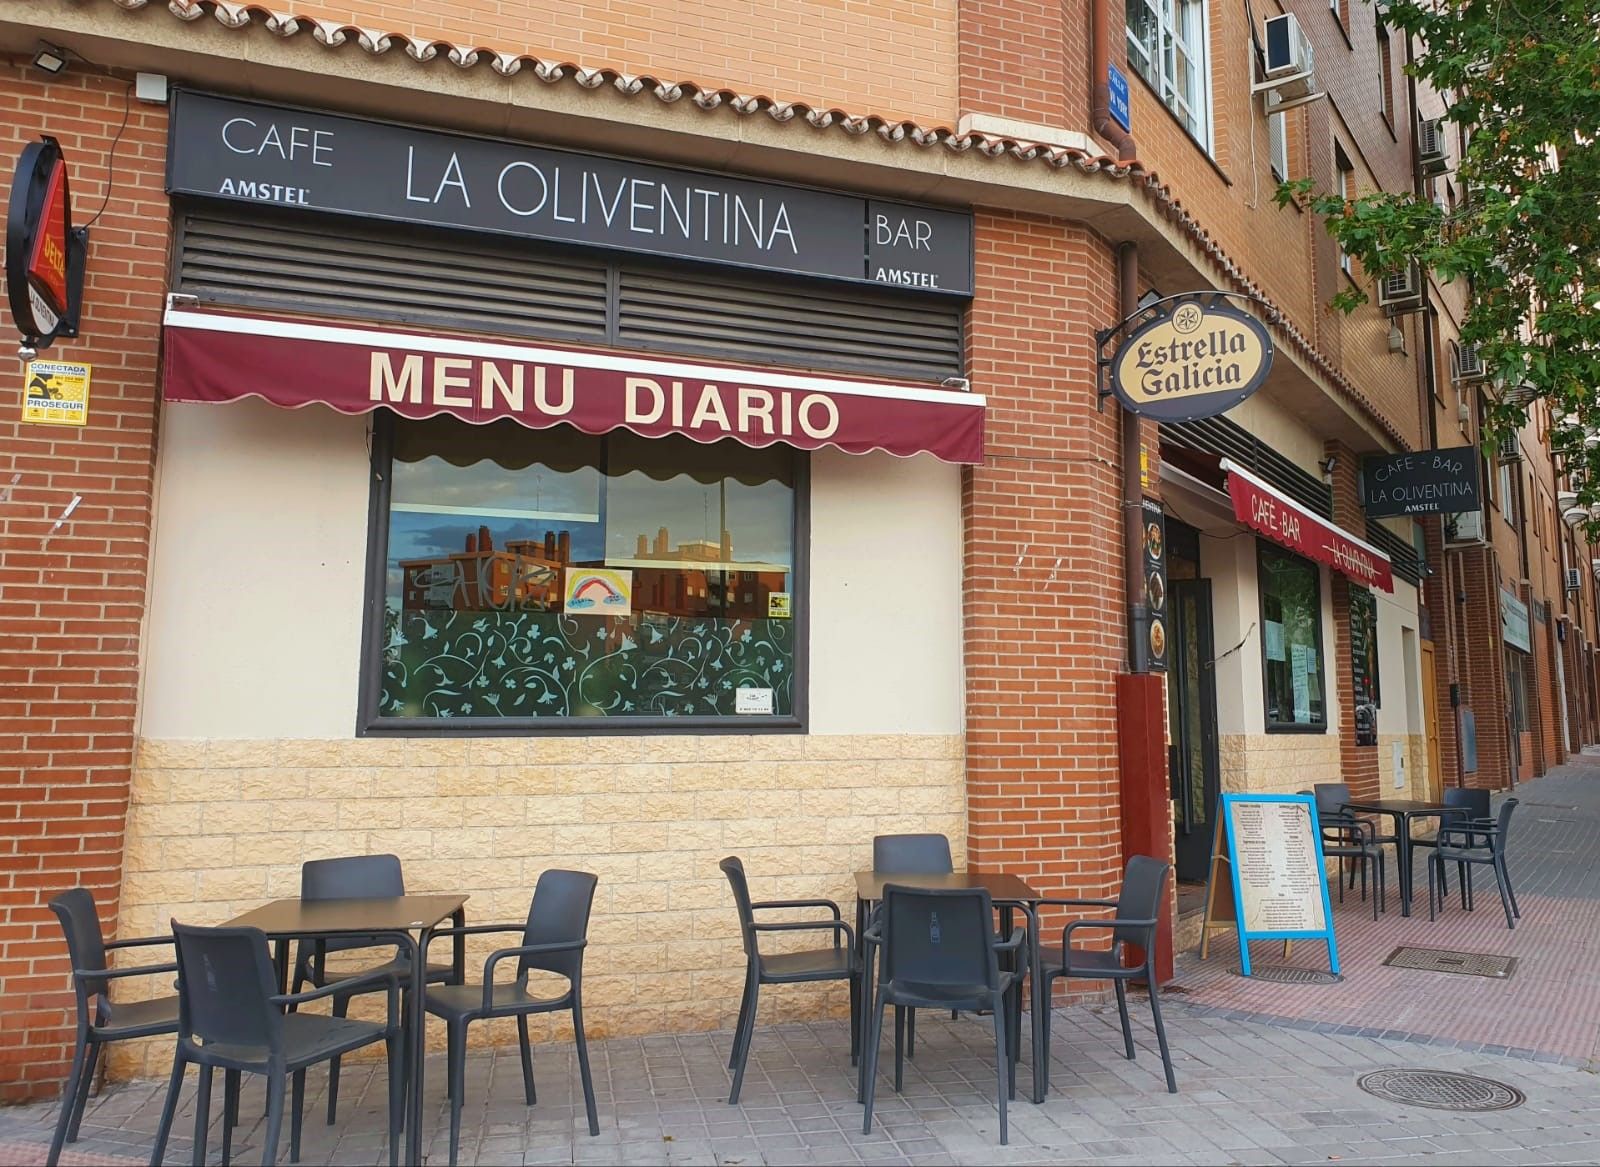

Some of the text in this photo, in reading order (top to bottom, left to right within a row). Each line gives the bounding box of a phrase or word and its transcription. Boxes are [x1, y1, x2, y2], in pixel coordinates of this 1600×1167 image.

[219, 177, 310, 206] AMSTEL
[222, 118, 933, 255] CAFE LA OLIVENTINA BAR
[875, 267, 939, 289] AMSTEL
[1136, 329, 1247, 369] Estrella
[30, 362, 86, 373] CONECTADA
[1141, 358, 1242, 396] Galicia
[27, 399, 84, 410] PROSEGUR
[369, 351, 841, 440] MENU DIARIO
[1375, 456, 1415, 482] CAFE
[1432, 455, 1463, 476] BAR
[1371, 481, 1473, 504] LA OLIVENTINA
[1404, 502, 1440, 513] AMSTEL
